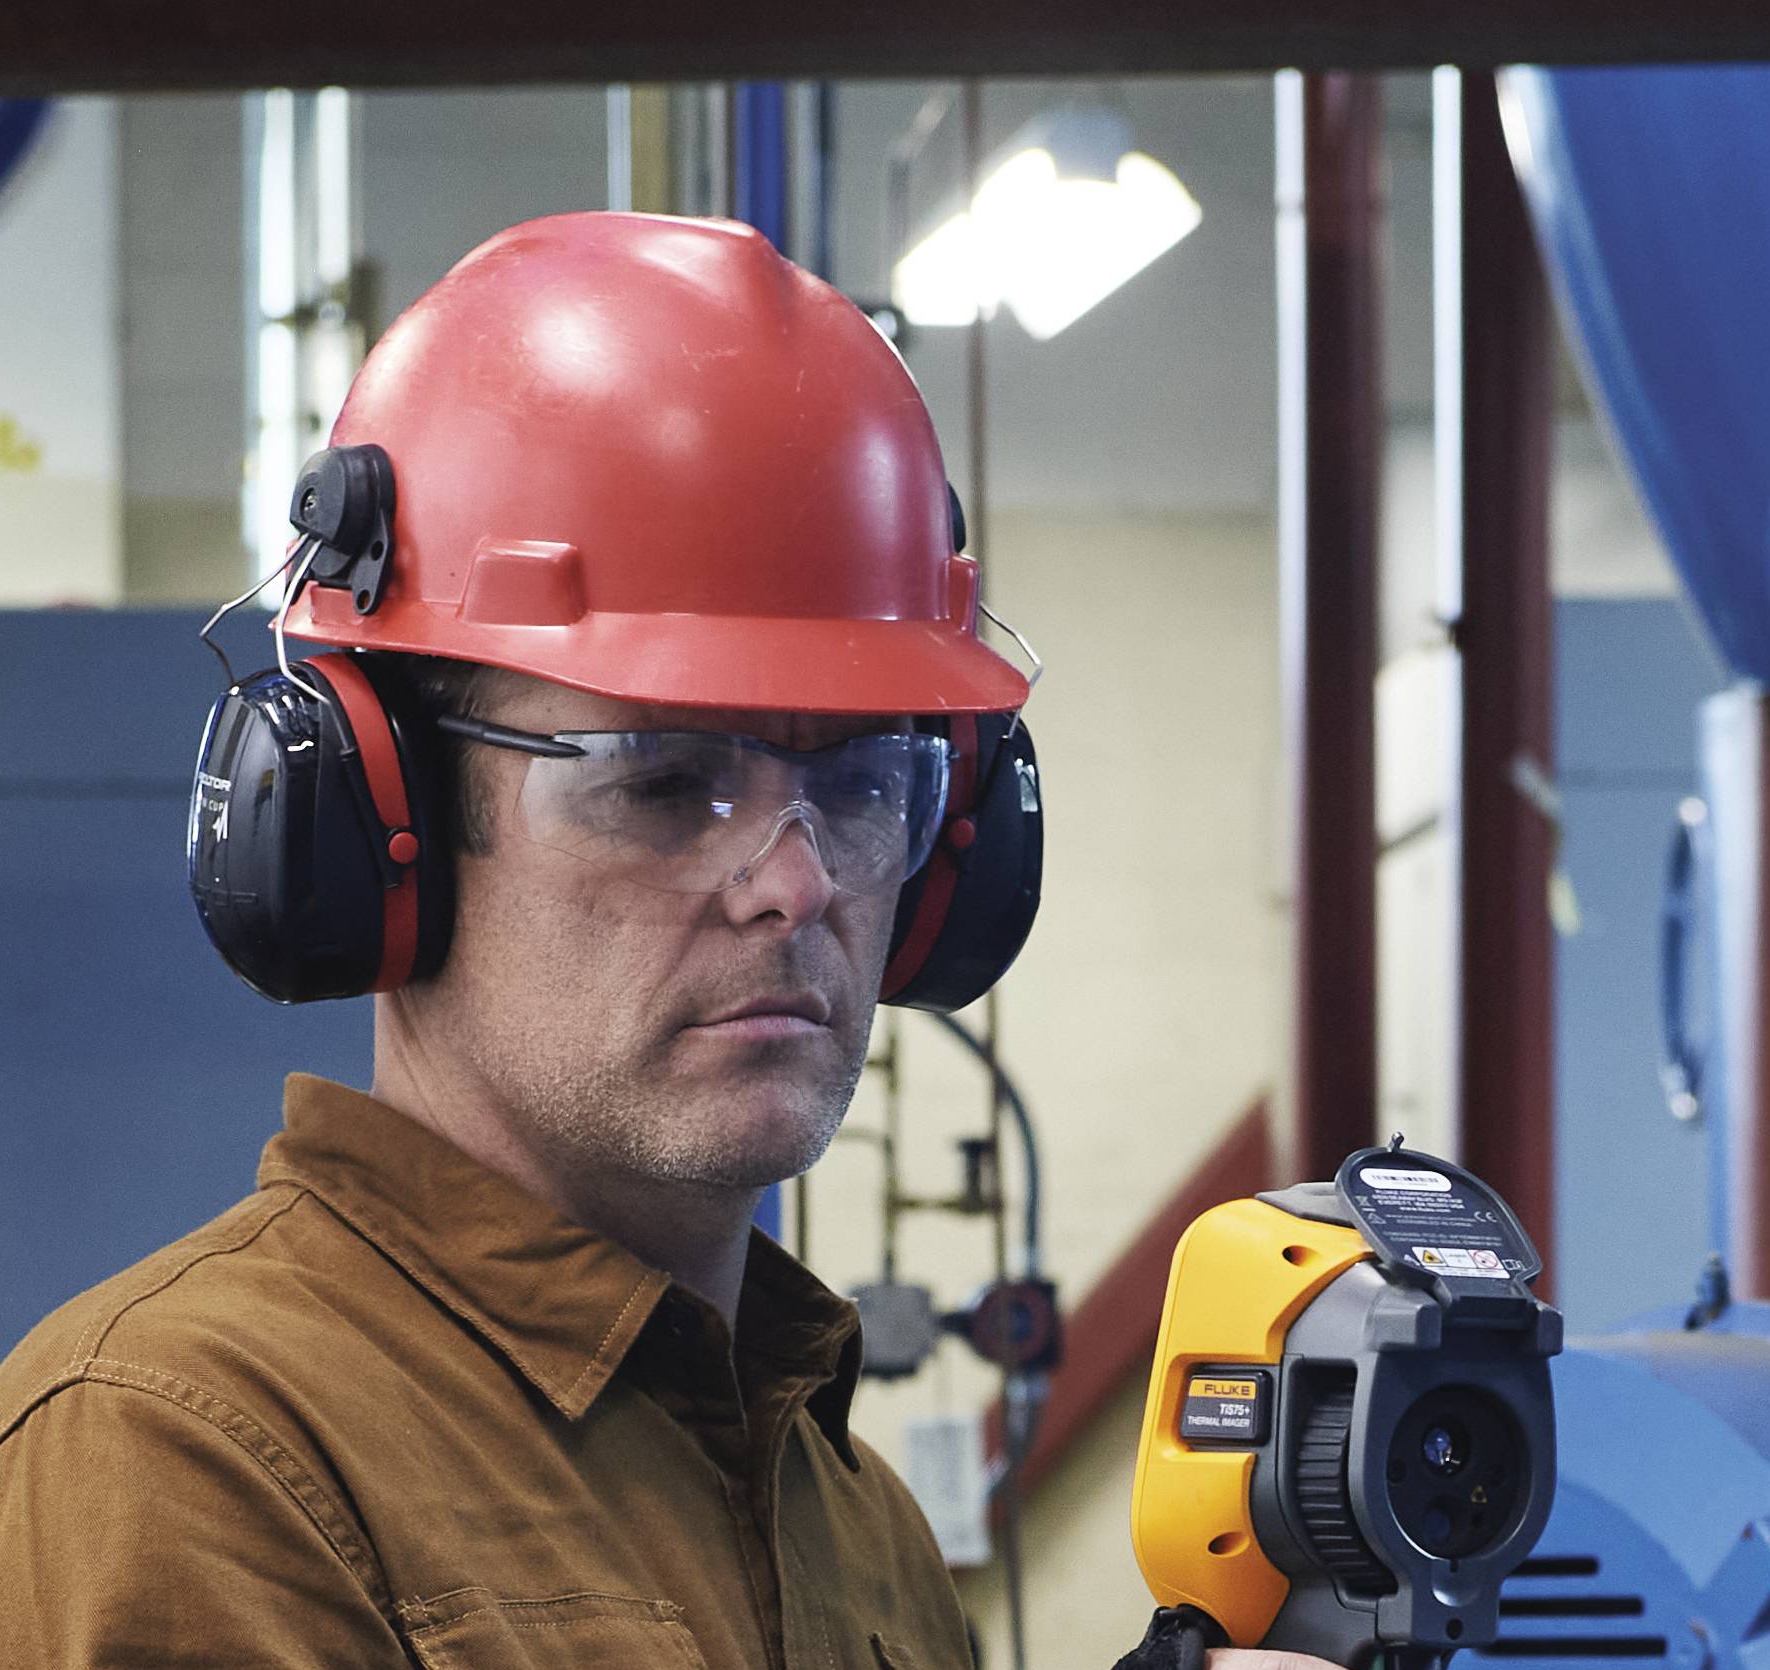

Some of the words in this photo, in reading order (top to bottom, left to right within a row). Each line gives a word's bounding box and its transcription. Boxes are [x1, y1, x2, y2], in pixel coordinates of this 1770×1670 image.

[1204, 1383, 1251, 1396] FLUKE
[1187, 1415, 1220, 1427] THERMAL
[1221, 1418, 1251, 1428] IMAGER
